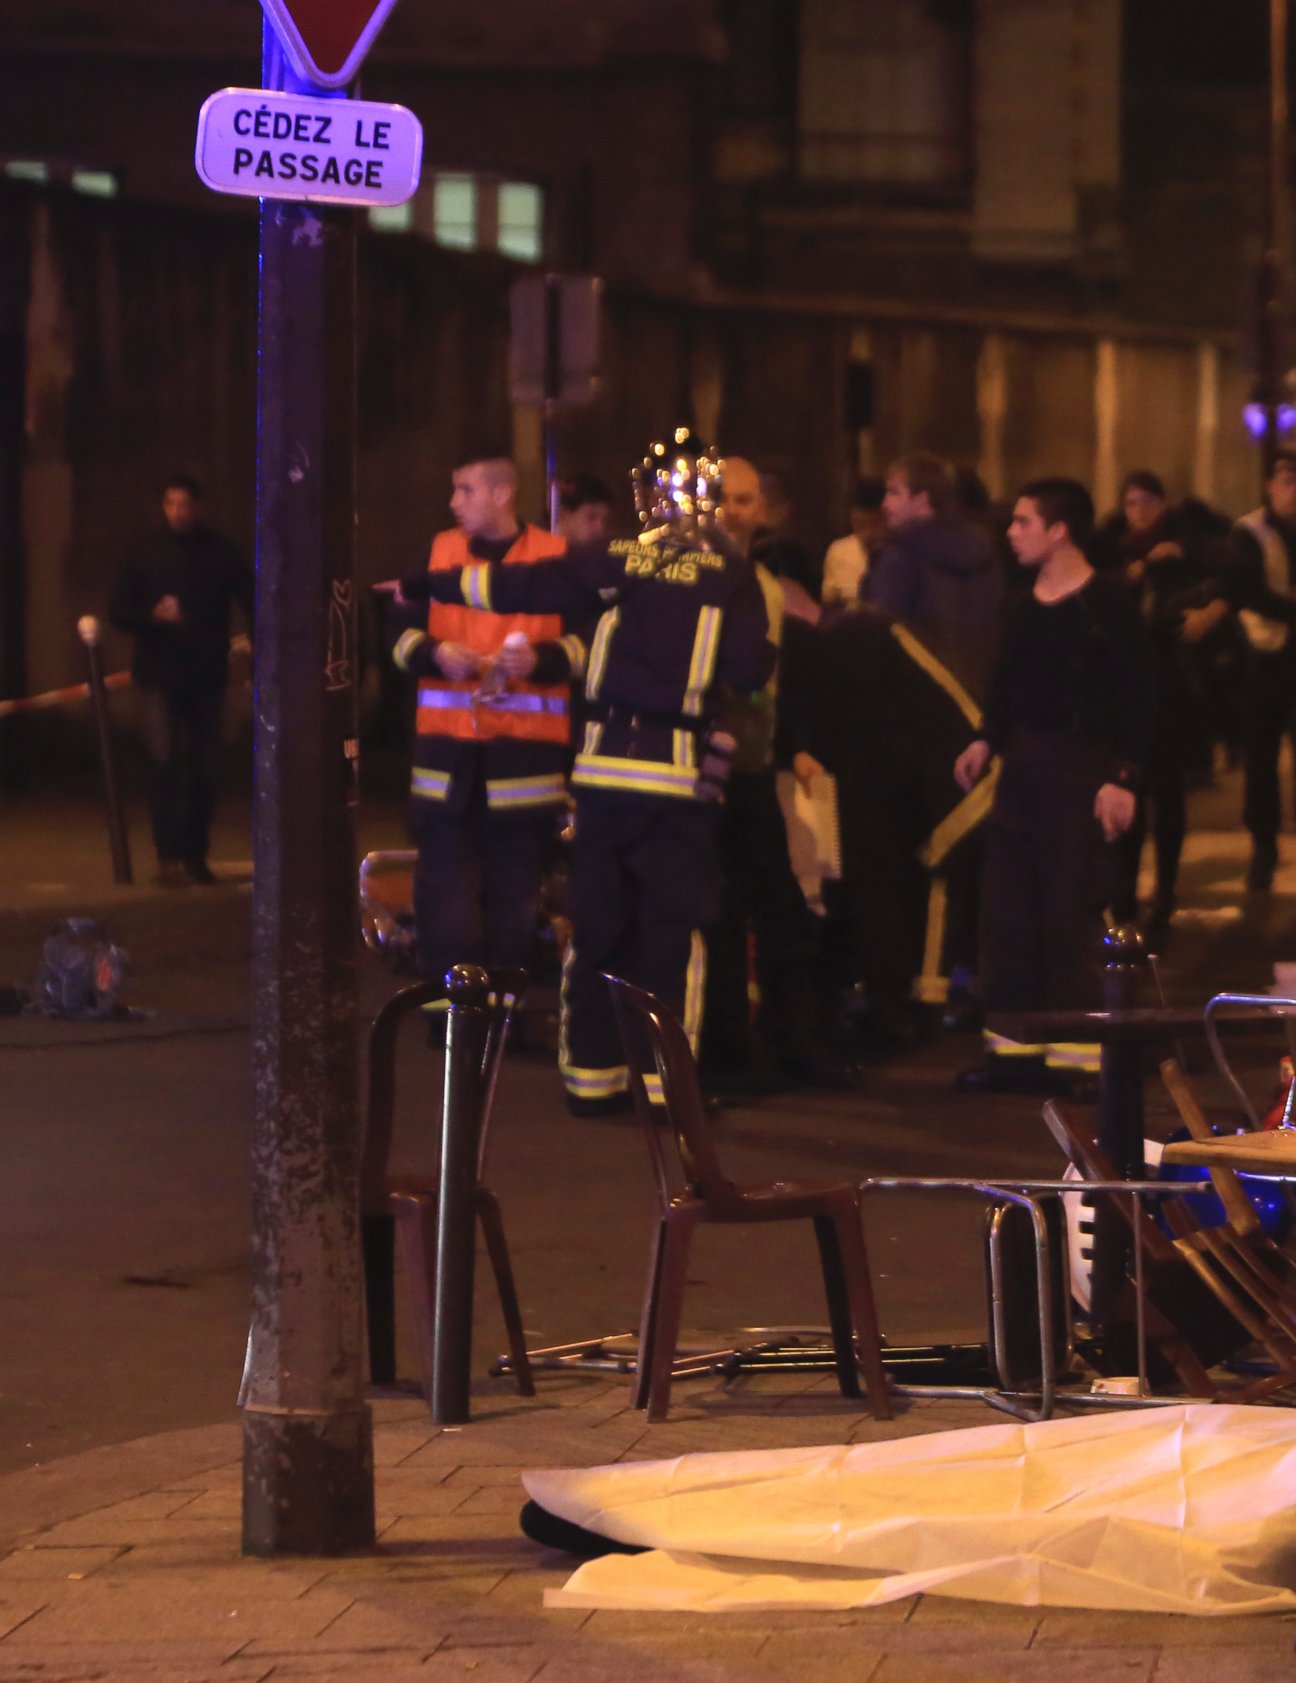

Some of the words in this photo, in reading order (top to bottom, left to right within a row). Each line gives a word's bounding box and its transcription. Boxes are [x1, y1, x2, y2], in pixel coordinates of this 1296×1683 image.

[233, 104, 332, 144] CÉDEZ
[355, 119, 391, 149] LE
[233, 148, 383, 188] PASSAGE
